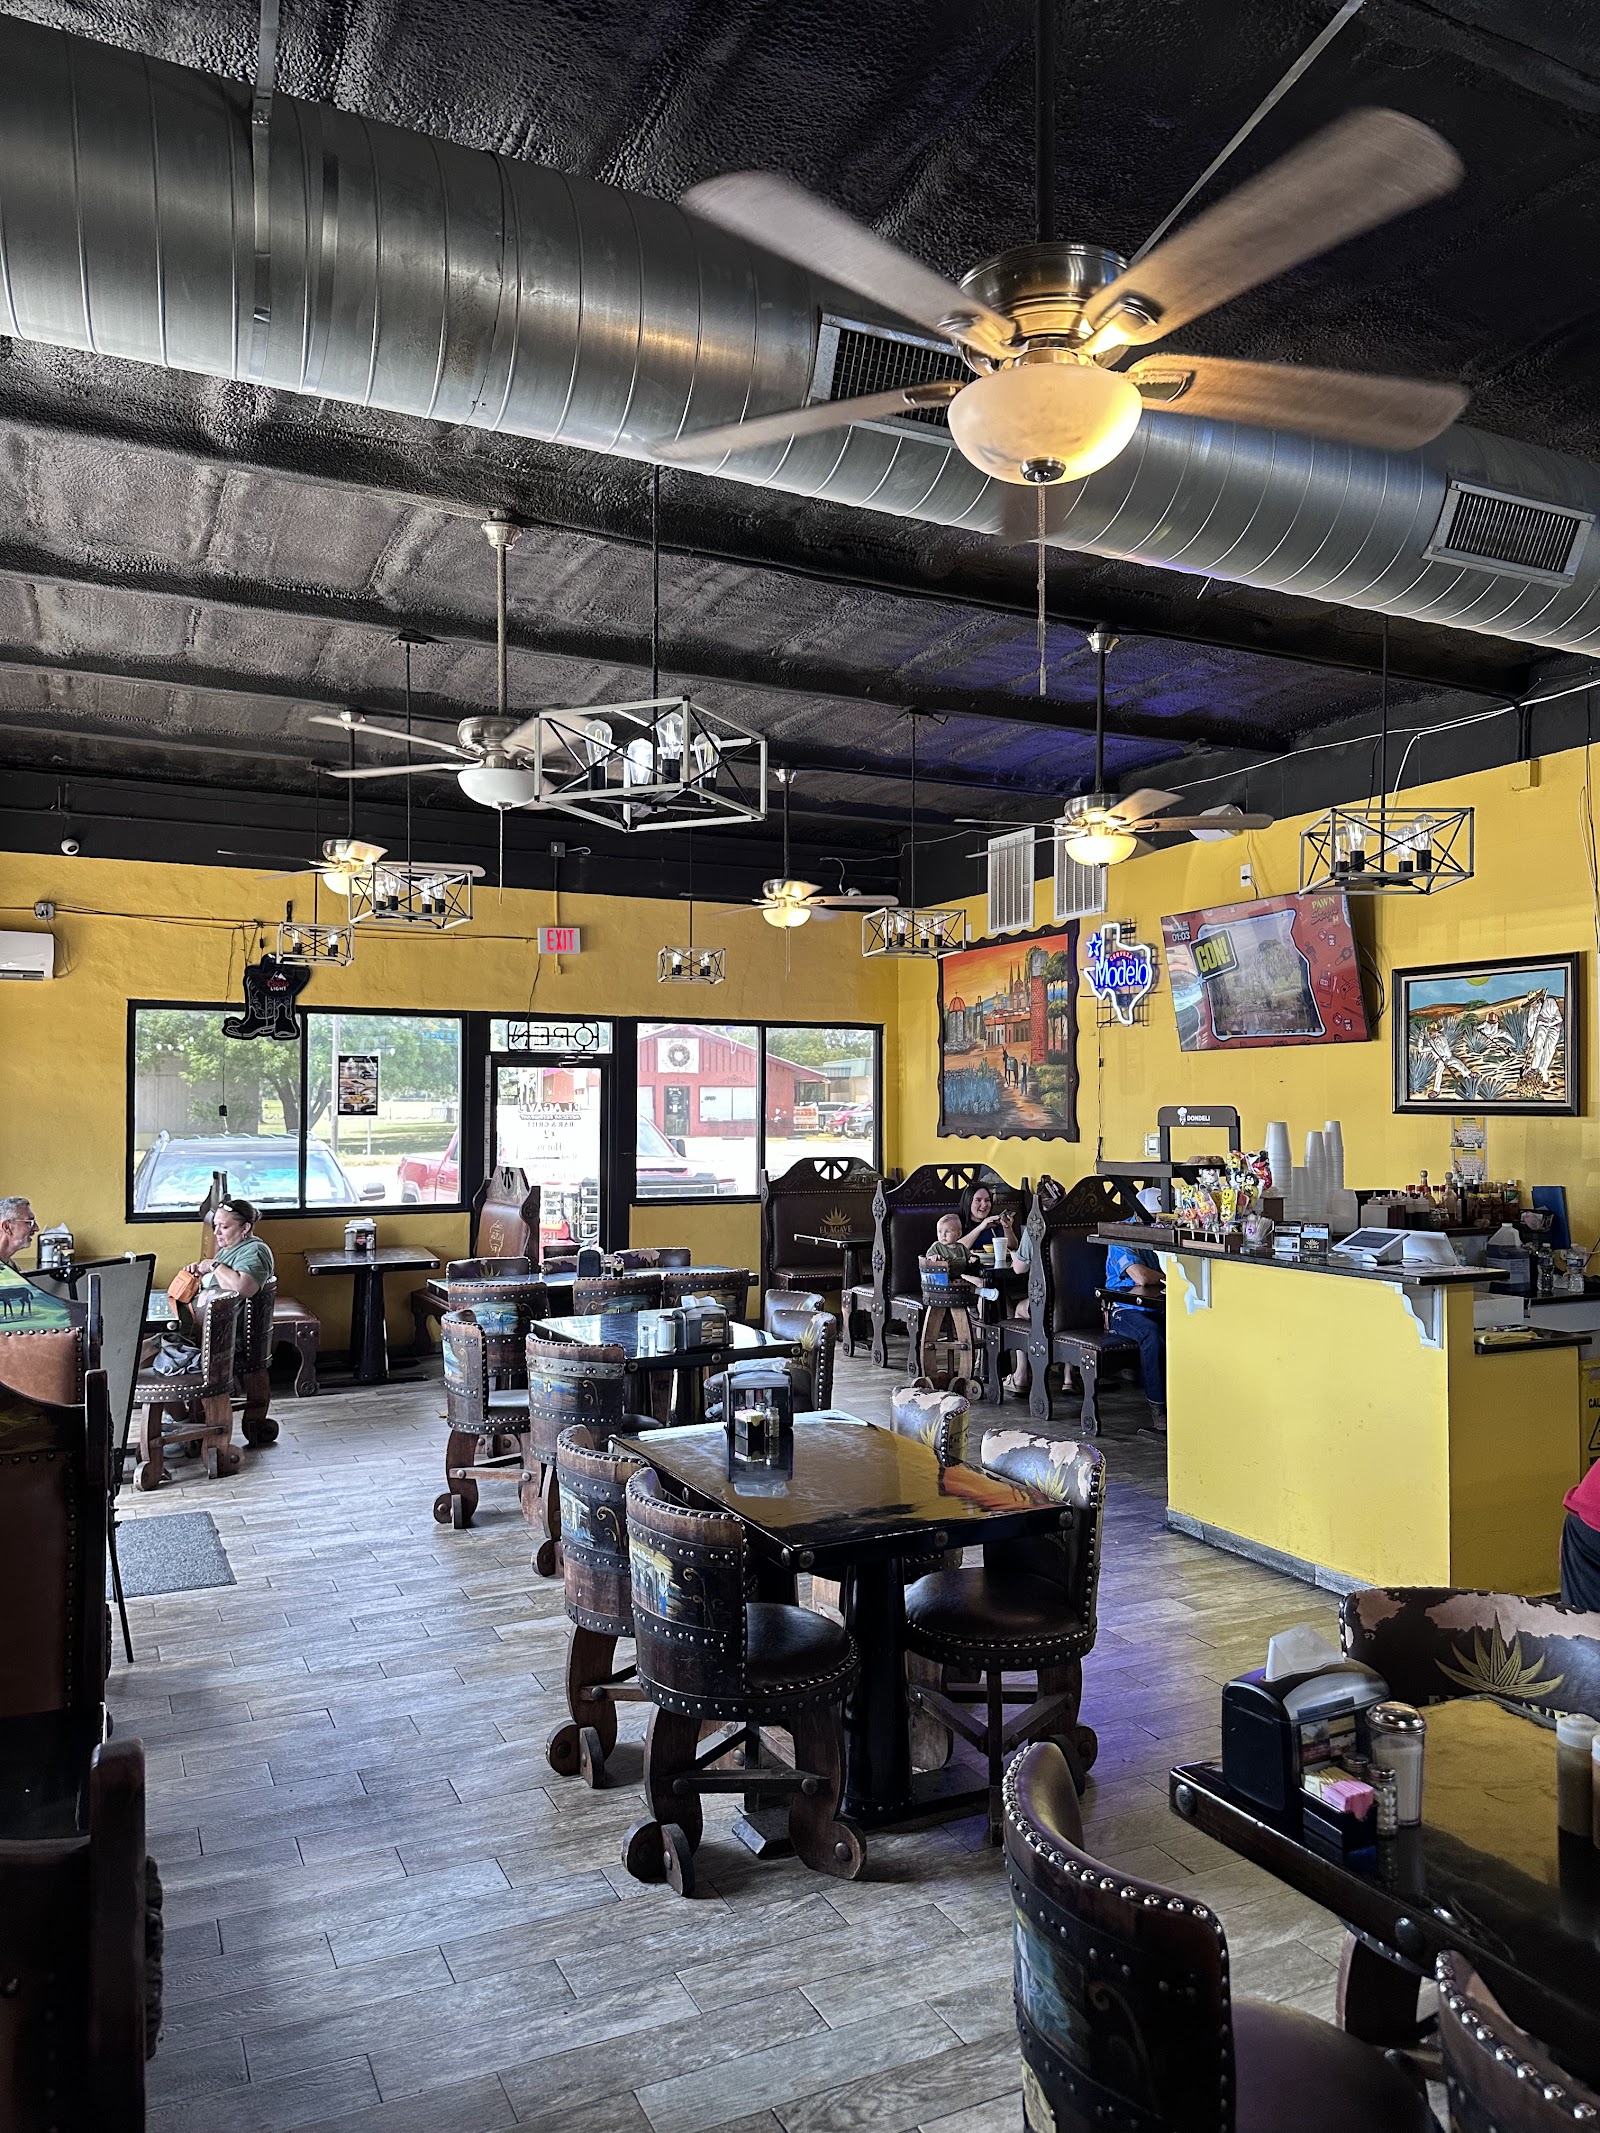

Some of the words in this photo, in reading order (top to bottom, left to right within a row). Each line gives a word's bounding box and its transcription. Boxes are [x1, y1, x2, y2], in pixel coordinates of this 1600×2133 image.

[1311, 895, 1336, 909] PAWN
[547, 929, 574, 951] EXIT
[1171, 931, 1191, 942] 01:03
[1109, 951, 1133, 962] CERVEZA
[1196, 937, 1231, 972] CON!
[1095, 958, 1149, 988] Modelo
[266, 979, 289, 987] Coors
[819, 1226, 829, 1234] EL
[829, 1225, 853, 1233] AGAVE
